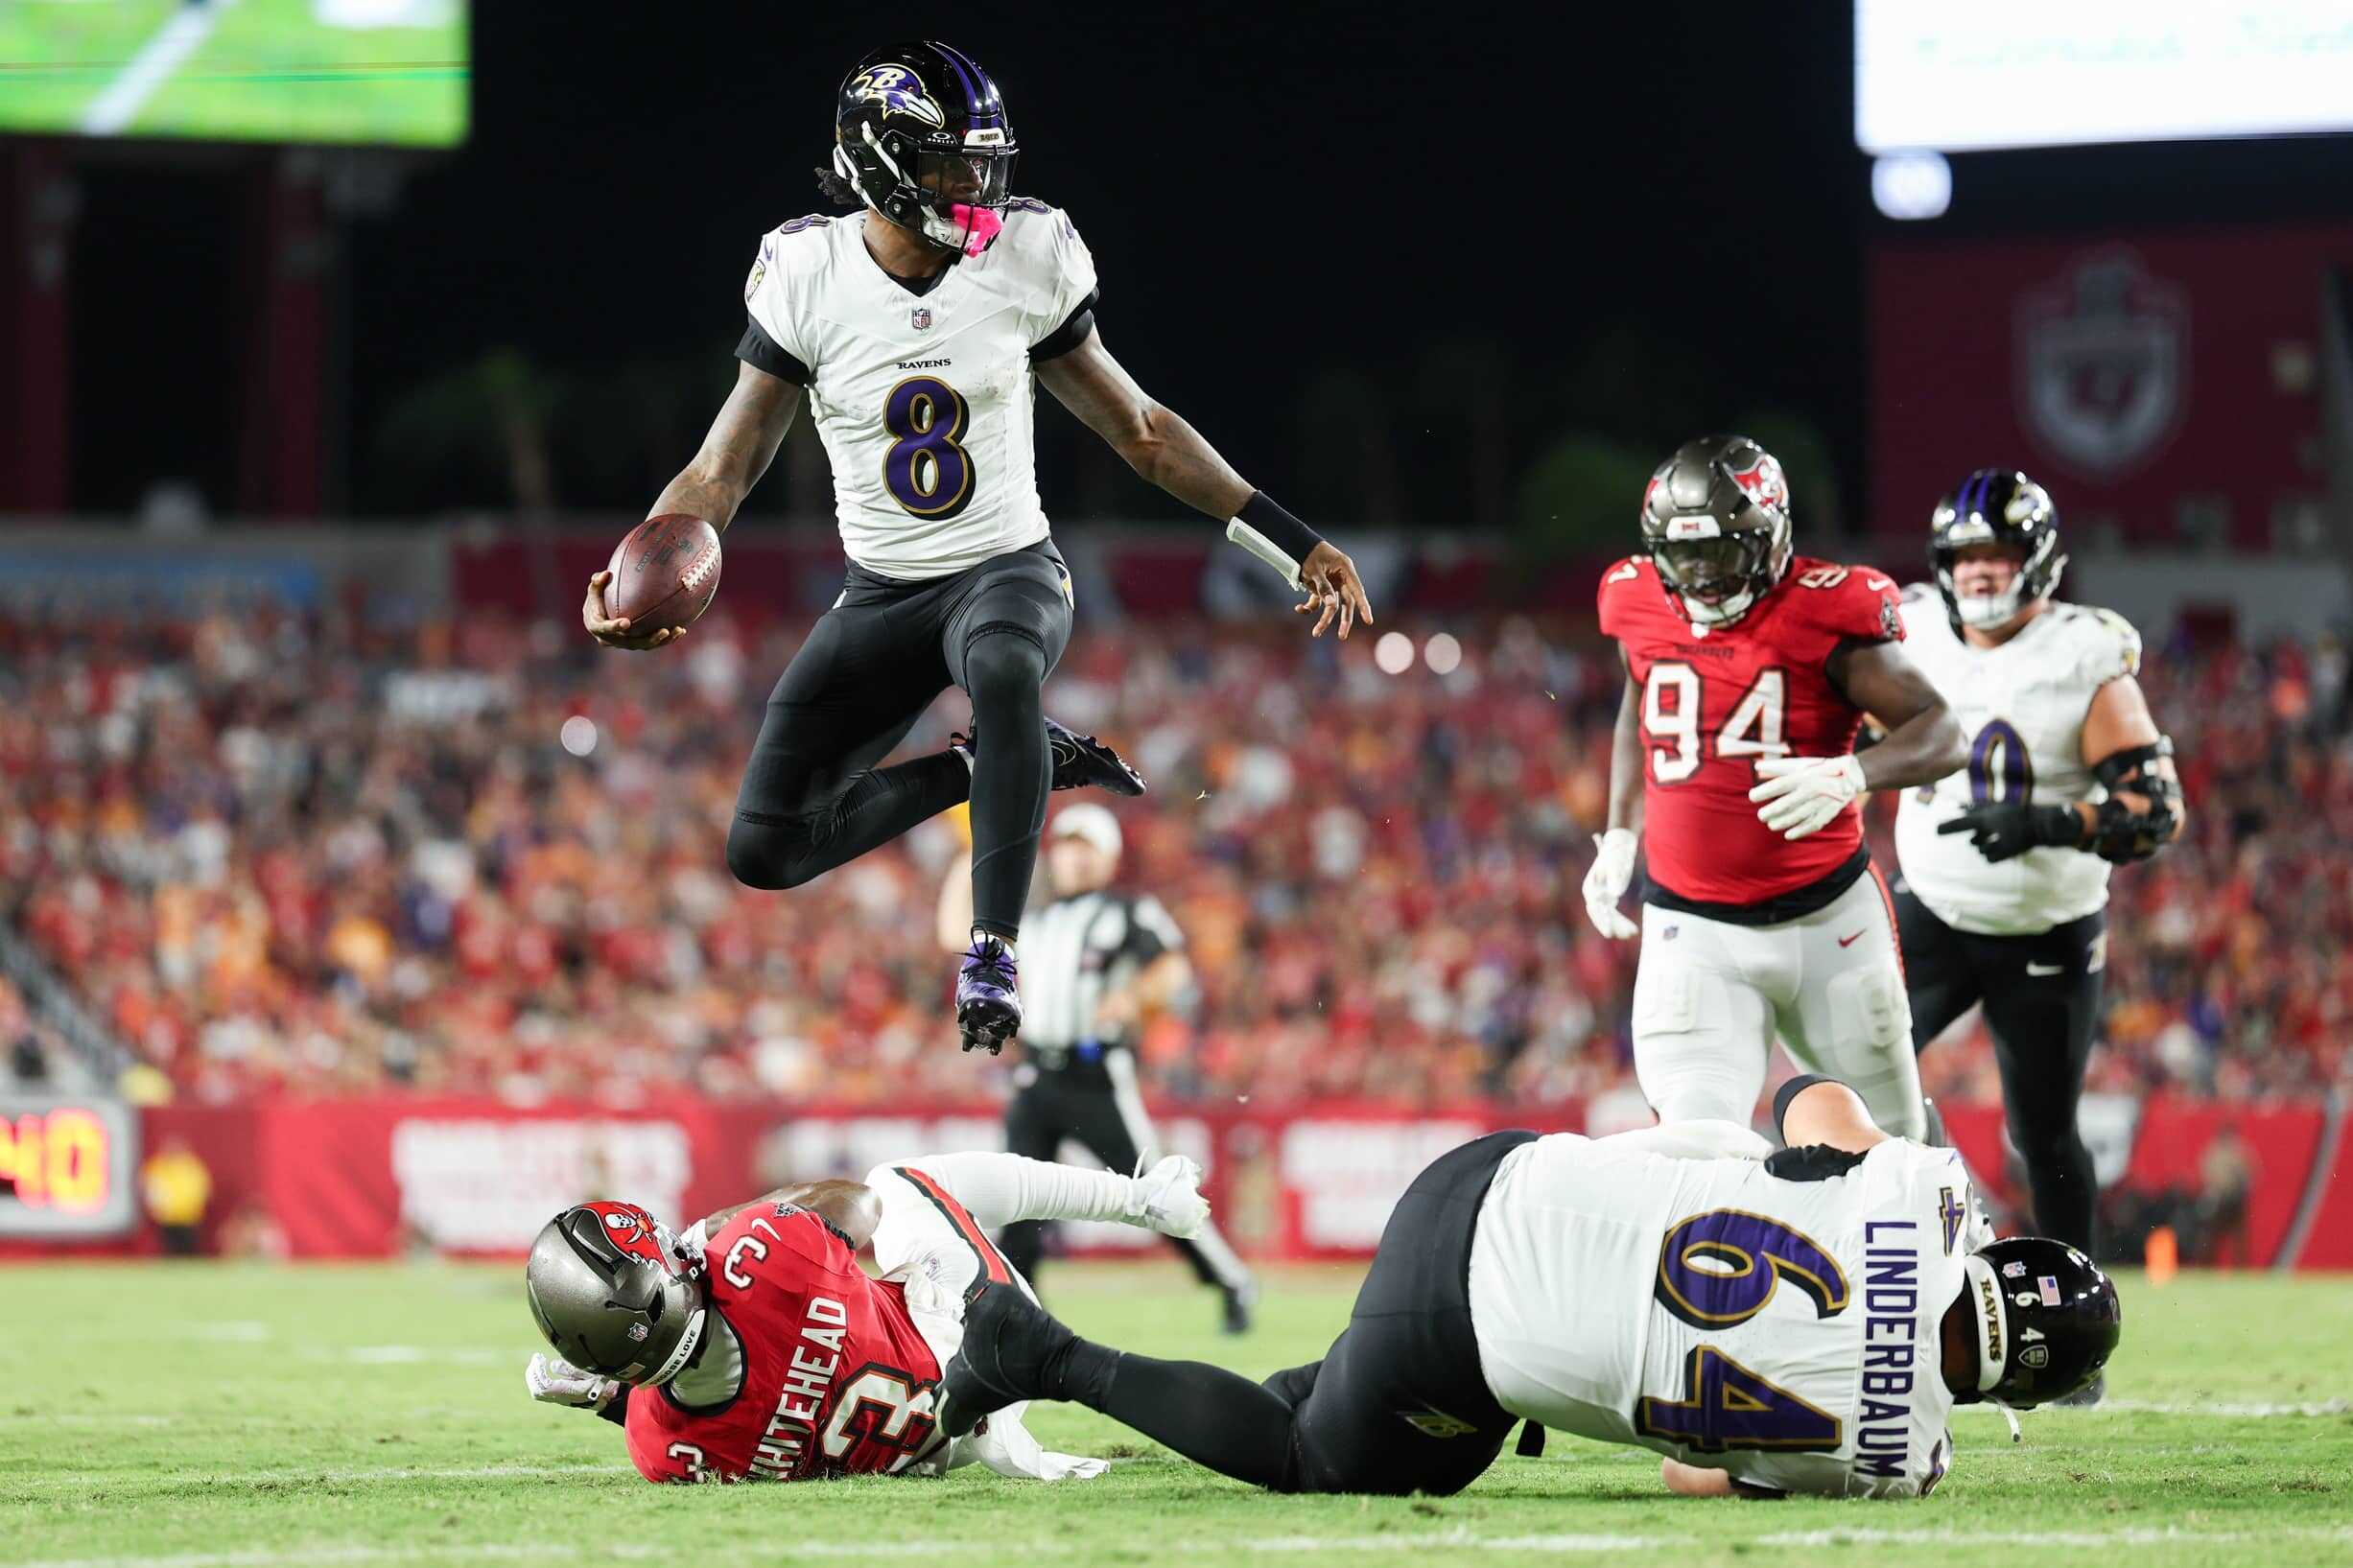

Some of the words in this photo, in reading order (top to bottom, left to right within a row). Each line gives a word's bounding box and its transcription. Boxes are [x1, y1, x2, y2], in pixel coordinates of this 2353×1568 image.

[874, 68, 906, 89] B
[927, 136, 954, 145] OAKLEY
[897, 358, 953, 370] RAVENS
[882, 375, 976, 522] 8
[1642, 658, 1794, 785] 94
[723, 1234, 769, 1291] 3
[679, 1329, 696, 1357] LOVE
[1635, 1207, 1850, 1454] 64
[1854, 1221, 1918, 1477] LINDERBAUM
[1980, 1276, 2003, 1363] RAVENS
[822, 1362, 937, 1474] 3
